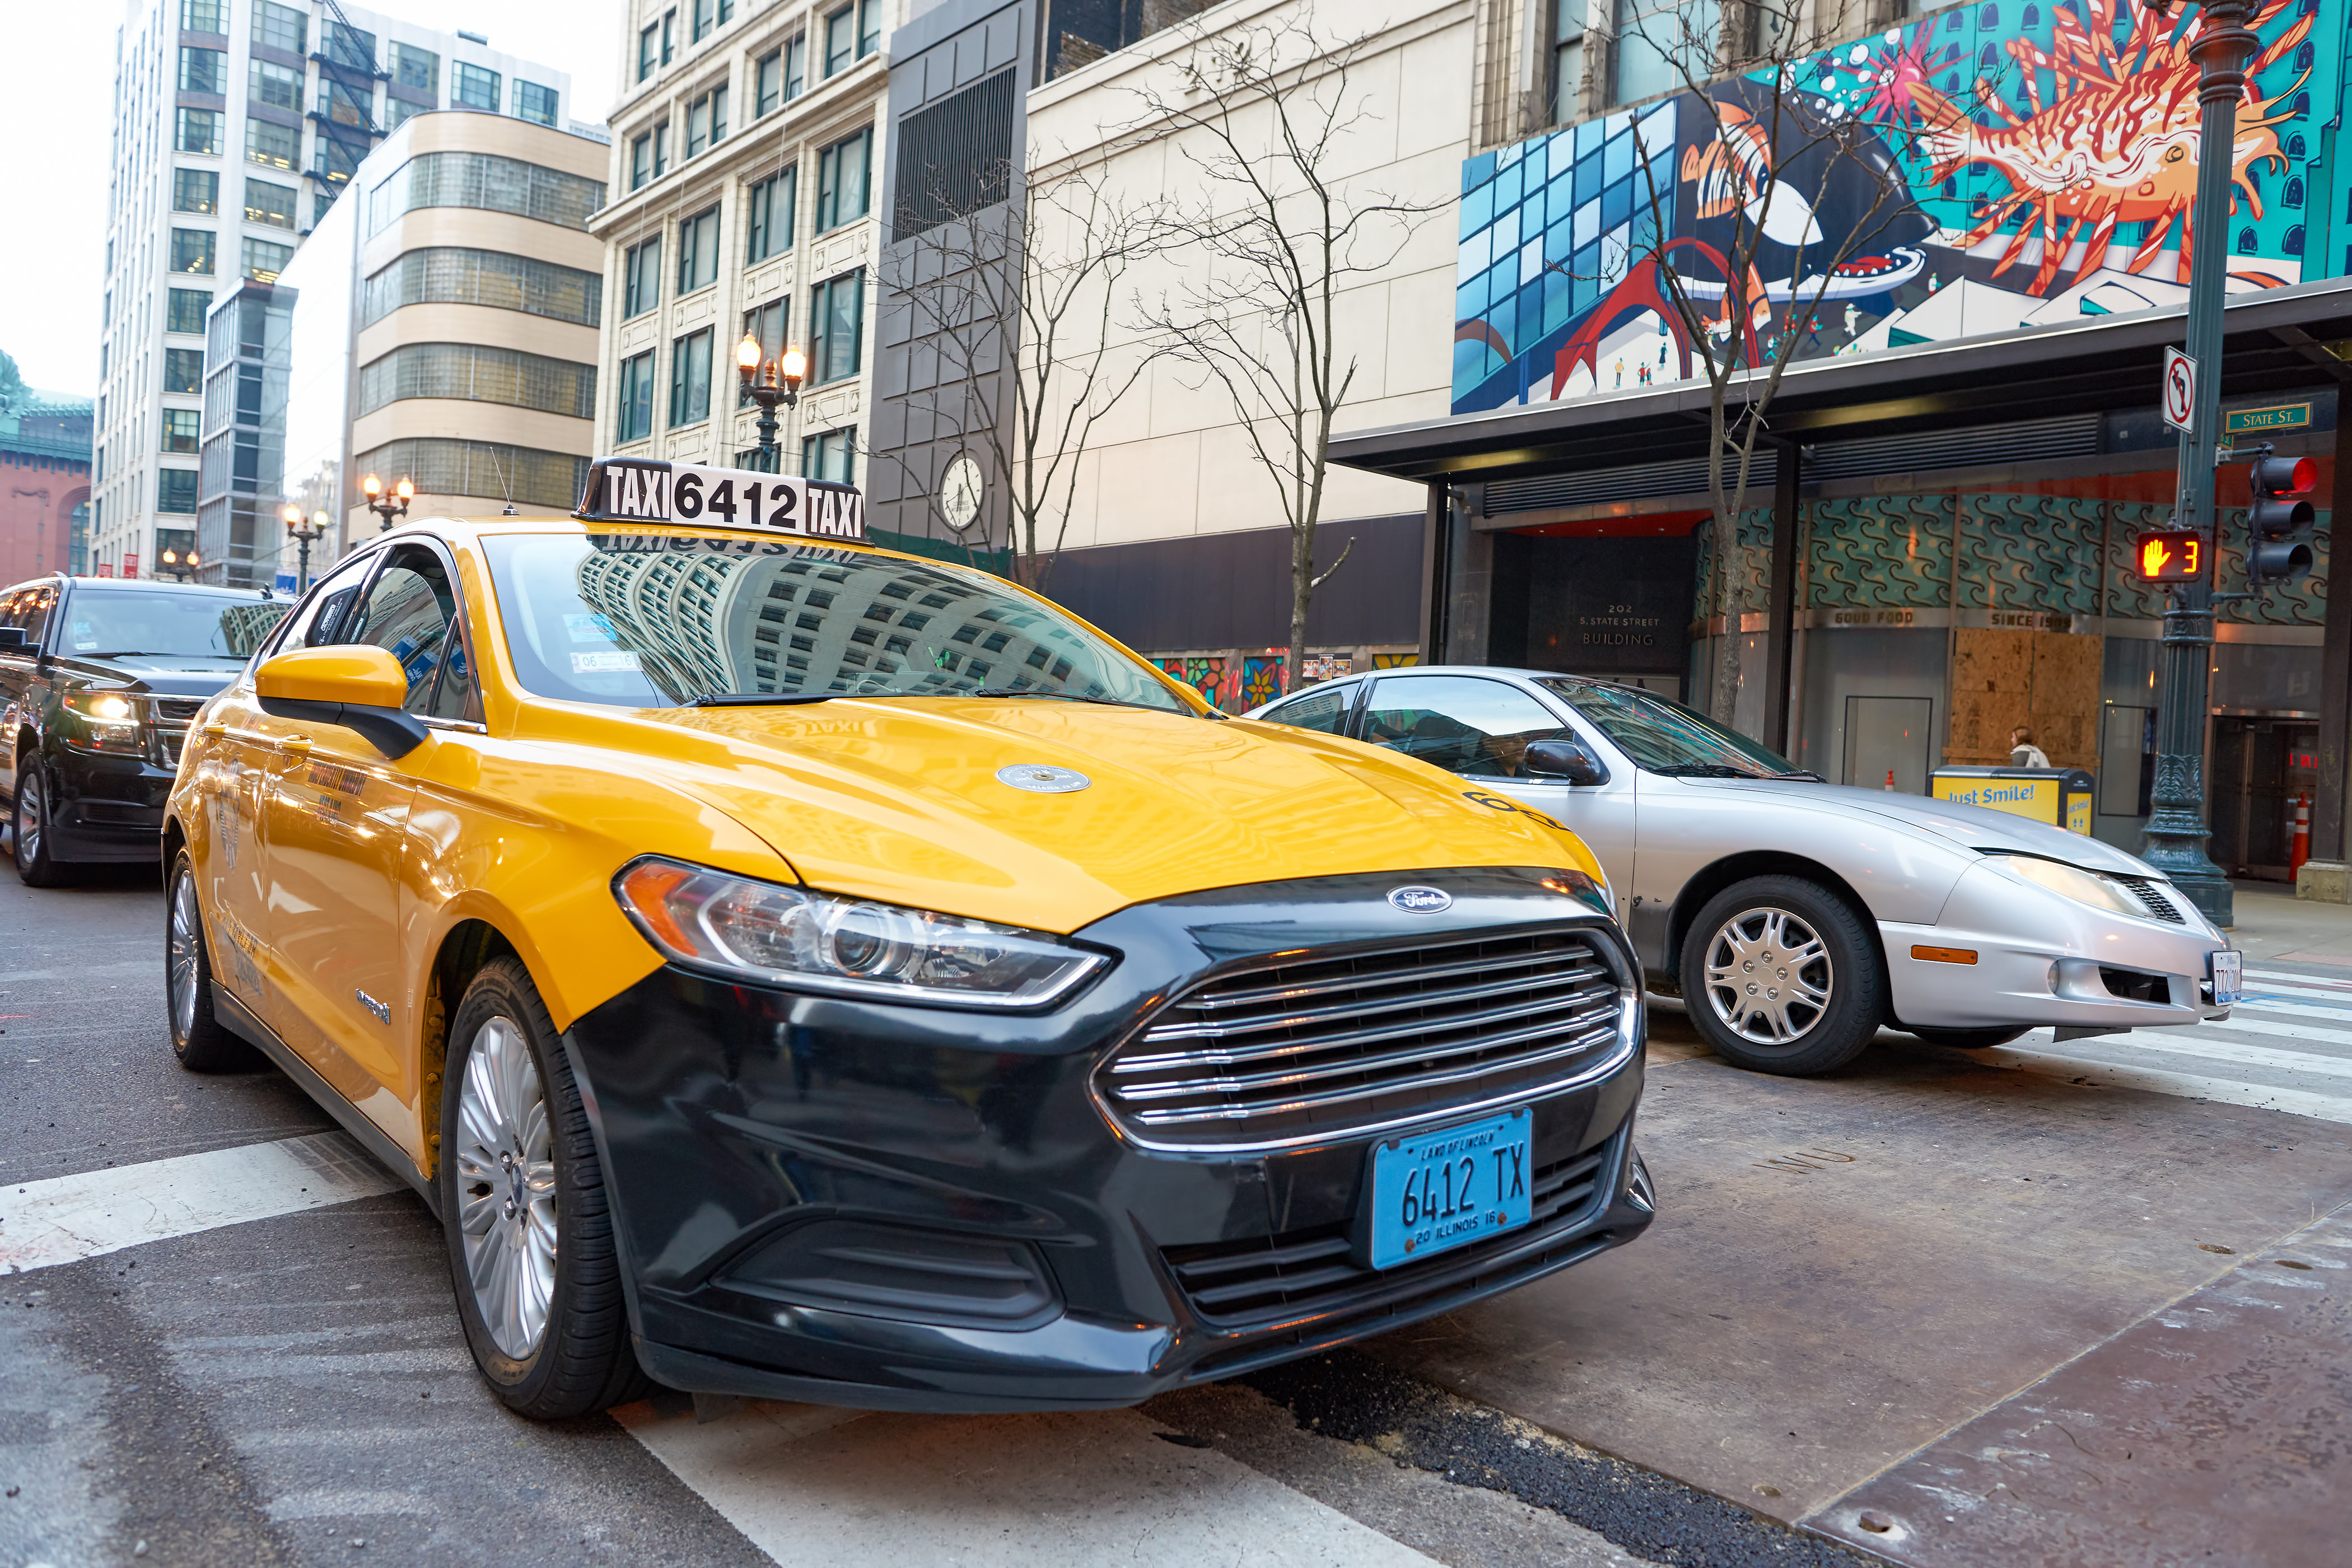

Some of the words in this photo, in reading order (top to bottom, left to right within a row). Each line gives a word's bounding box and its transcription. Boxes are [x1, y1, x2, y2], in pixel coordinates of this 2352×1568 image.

[2243, 414, 2274, 427] STATE
[2278, 410, 2294, 424] ST.
[606, 466, 670, 519] TAXI
[674, 473, 797, 529] 6412
[808, 488, 862, 538] TAXI
[2183, 540, 2199, 574] 3
[1580, 617, 1588, 625] S.
[1590, 617, 1618, 626] STATE
[1623, 618, 1659, 626] STREET
[1835, 612, 1870, 624] GOOD
[1877, 612, 1913, 624] FOOD
[1991, 614, 2033, 627] SINCE
[1583, 633, 1653, 645] BUILDING
[1983, 784, 2035, 803] Smile!
[1403, 891, 1438, 907] Ford
[1402, 1157, 1474, 1226] 6412
[1492, 1142, 1524, 1202] TX
[1416, 1230, 1430, 1244] 20
[1436, 1216, 1478, 1239] ILLINOIS
